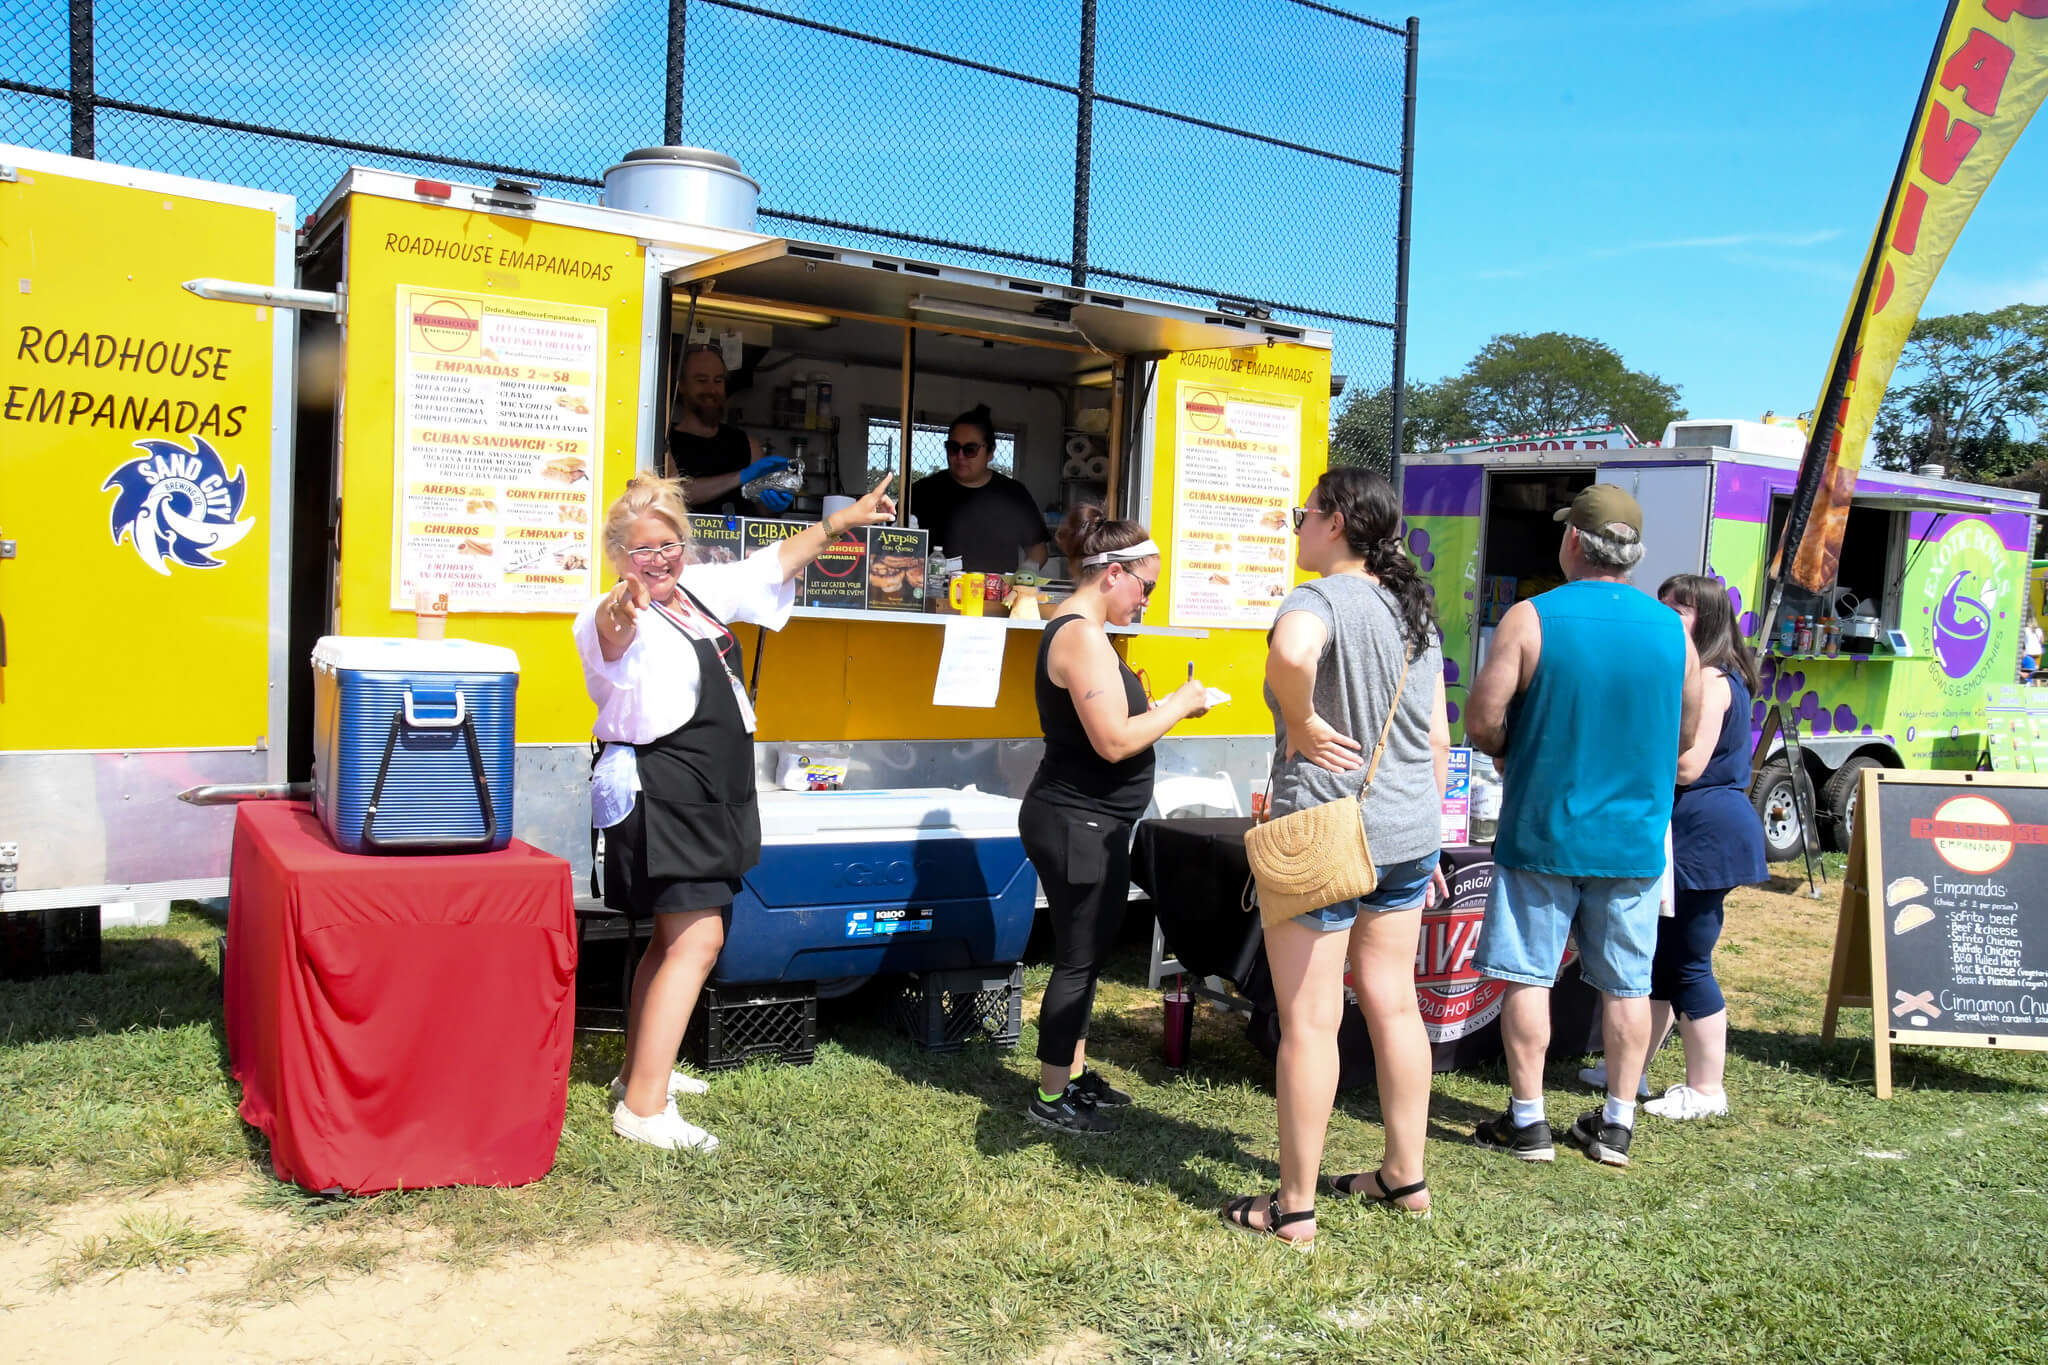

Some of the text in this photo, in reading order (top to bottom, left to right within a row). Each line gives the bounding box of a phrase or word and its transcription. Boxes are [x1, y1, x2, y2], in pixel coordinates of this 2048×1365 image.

[384, 232, 614, 282] ROADHOUSE EMAPANADAS
[17, 325, 232, 381] ROADHOUSE
[1180, 350, 1244, 373] ROADHOUSE
[435, 359, 570, 383] EMPANADAS 2 $8
[3, 385, 247, 438] EMPANADAS
[422, 431, 579, 453] CUBAN SANDWICH $12
[137, 453, 232, 520] SAND CITY
[164, 481, 197, 497] BREWING
[422, 484, 466, 496] AREPAS
[506, 489, 586, 503] CORN FRITTERS
[1188, 490, 1218, 502] CUBAN
[1218, 493, 1263, 506] SANDWICH
[424, 524, 480, 536] CHURROS
[694, 519, 724, 529] CRAZY
[749, 523, 803, 541] CUBAN
[703, 530, 741, 540] FRITTERS
[878, 531, 919, 546] Arepas
[1924, 527, 2011, 598] EXOTIC BOWLS
[525, 575, 565, 585] DRINKS
[1962, 631, 2004, 696] SMOOTHIES
[1940, 839, 2007, 855] EMPANADAS
[876, 910, 905, 920] IGLOO
[1950, 910, 2018, 925] Sofrito beef
[847, 920, 858, 935] 7
[1951, 921, 2018, 937] Beef & cheese
[1951, 931, 2022, 948] Sofrito Chicken
[1952, 942, 2021, 958] Buffalo Chicken
[1953, 952, 2021, 967] BBQ Pulled Pork
[1955, 964, 2016, 976] Mac & Cheese
[1956, 974, 1977, 985] Bean
[1987, 976, 2020, 987] Plantain
[1940, 989, 2015, 1015] Cinnamon
[1953, 1011, 1980, 1022] Served
[1981, 1012, 2000, 1022] with
[2002, 1015, 2032, 1024] caramel
